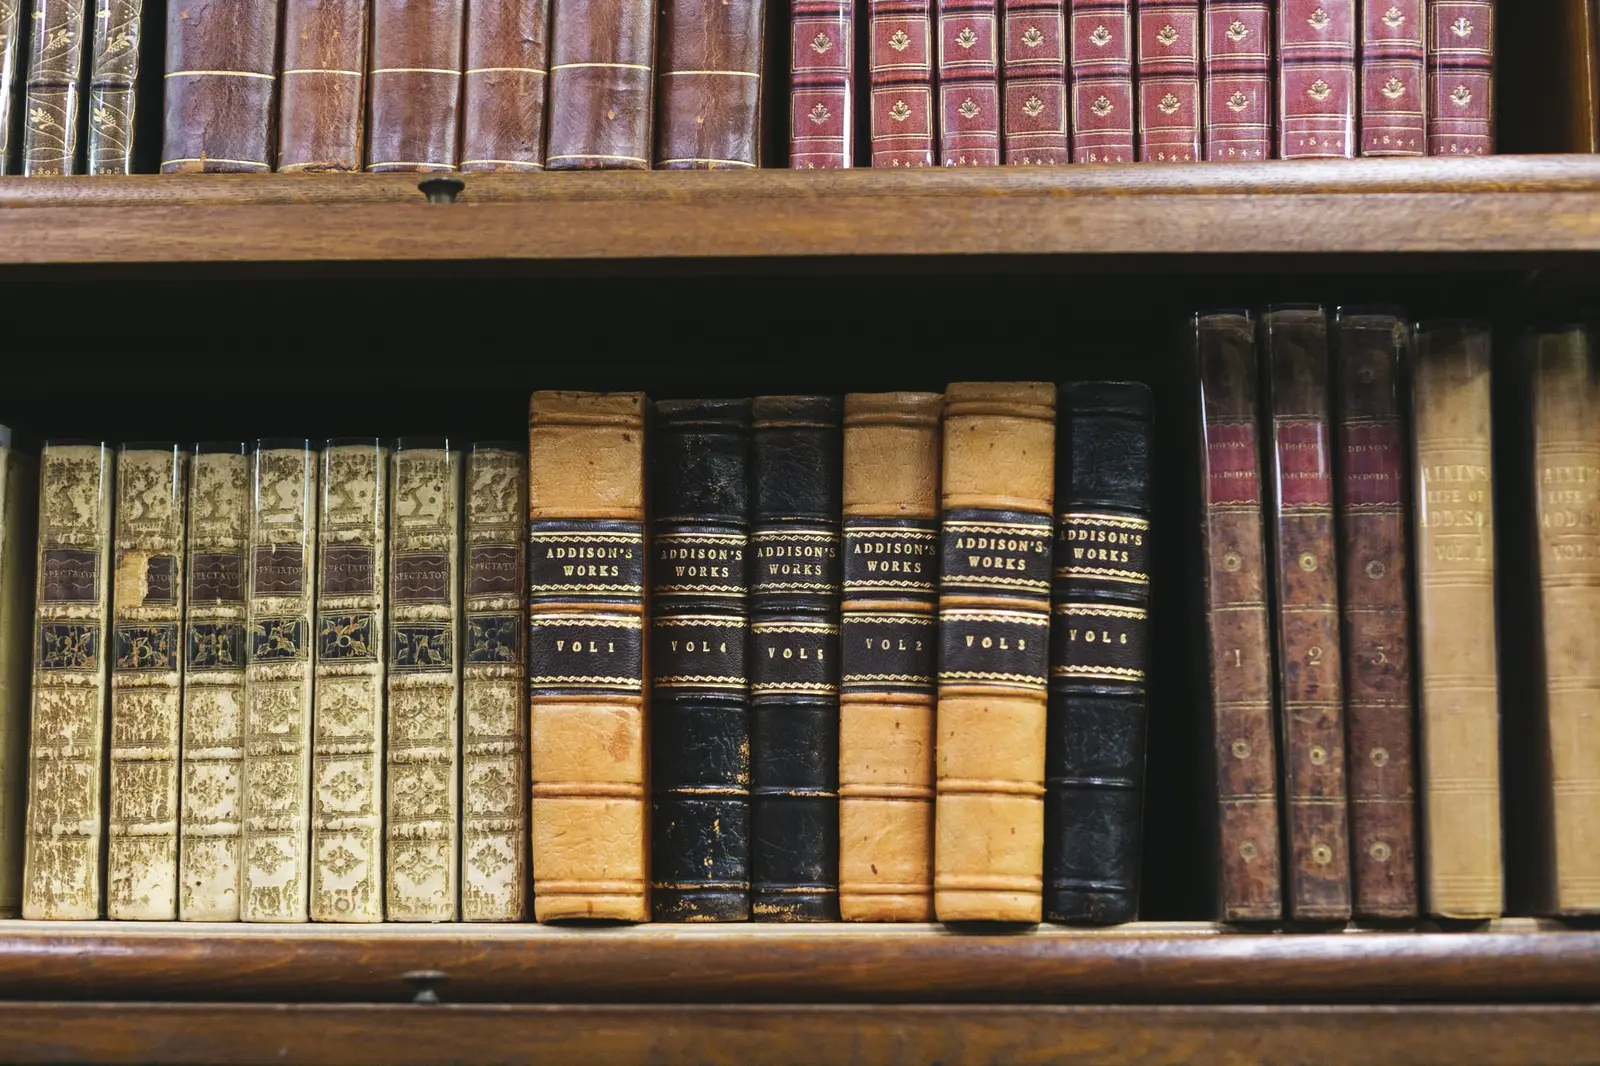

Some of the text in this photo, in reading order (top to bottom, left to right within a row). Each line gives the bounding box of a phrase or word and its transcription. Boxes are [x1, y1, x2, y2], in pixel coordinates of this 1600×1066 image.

[1299, 136, 1342, 148] 1844
[1372, 135, 1415, 146] 1844
[1217, 147, 1261, 157] 1844
[1439, 143, 1483, 154] 1844
[1427, 489, 1461, 503] LIFE
[854, 543, 936, 555] ADDISON'S
[955, 537, 1043, 553] ADDISON'S
[546, 547, 633, 559] ADDISON'S
[660, 549, 743, 560] ADDISON'S
[757, 546, 836, 558] ADDISON'S
[1073, 548, 1129, 563] WORKS
[867, 560, 921, 573] WORKS
[968, 556, 1026, 571] WORKS
[563, 565, 619, 577] WORKS
[675, 566, 729, 577] WORKS
[769, 564, 822, 576] WORKS
[965, 636, 1009, 649] VOL
[1069, 629, 1112, 644] VOL
[556, 640, 614, 653] VOL 1
[671, 641, 710, 653] VOL
[866, 638, 922, 651] VOL 2
[768, 647, 824, 660] VOL 5
[1234, 649, 1242, 668] 1
[1308, 645, 1323, 666] 2
